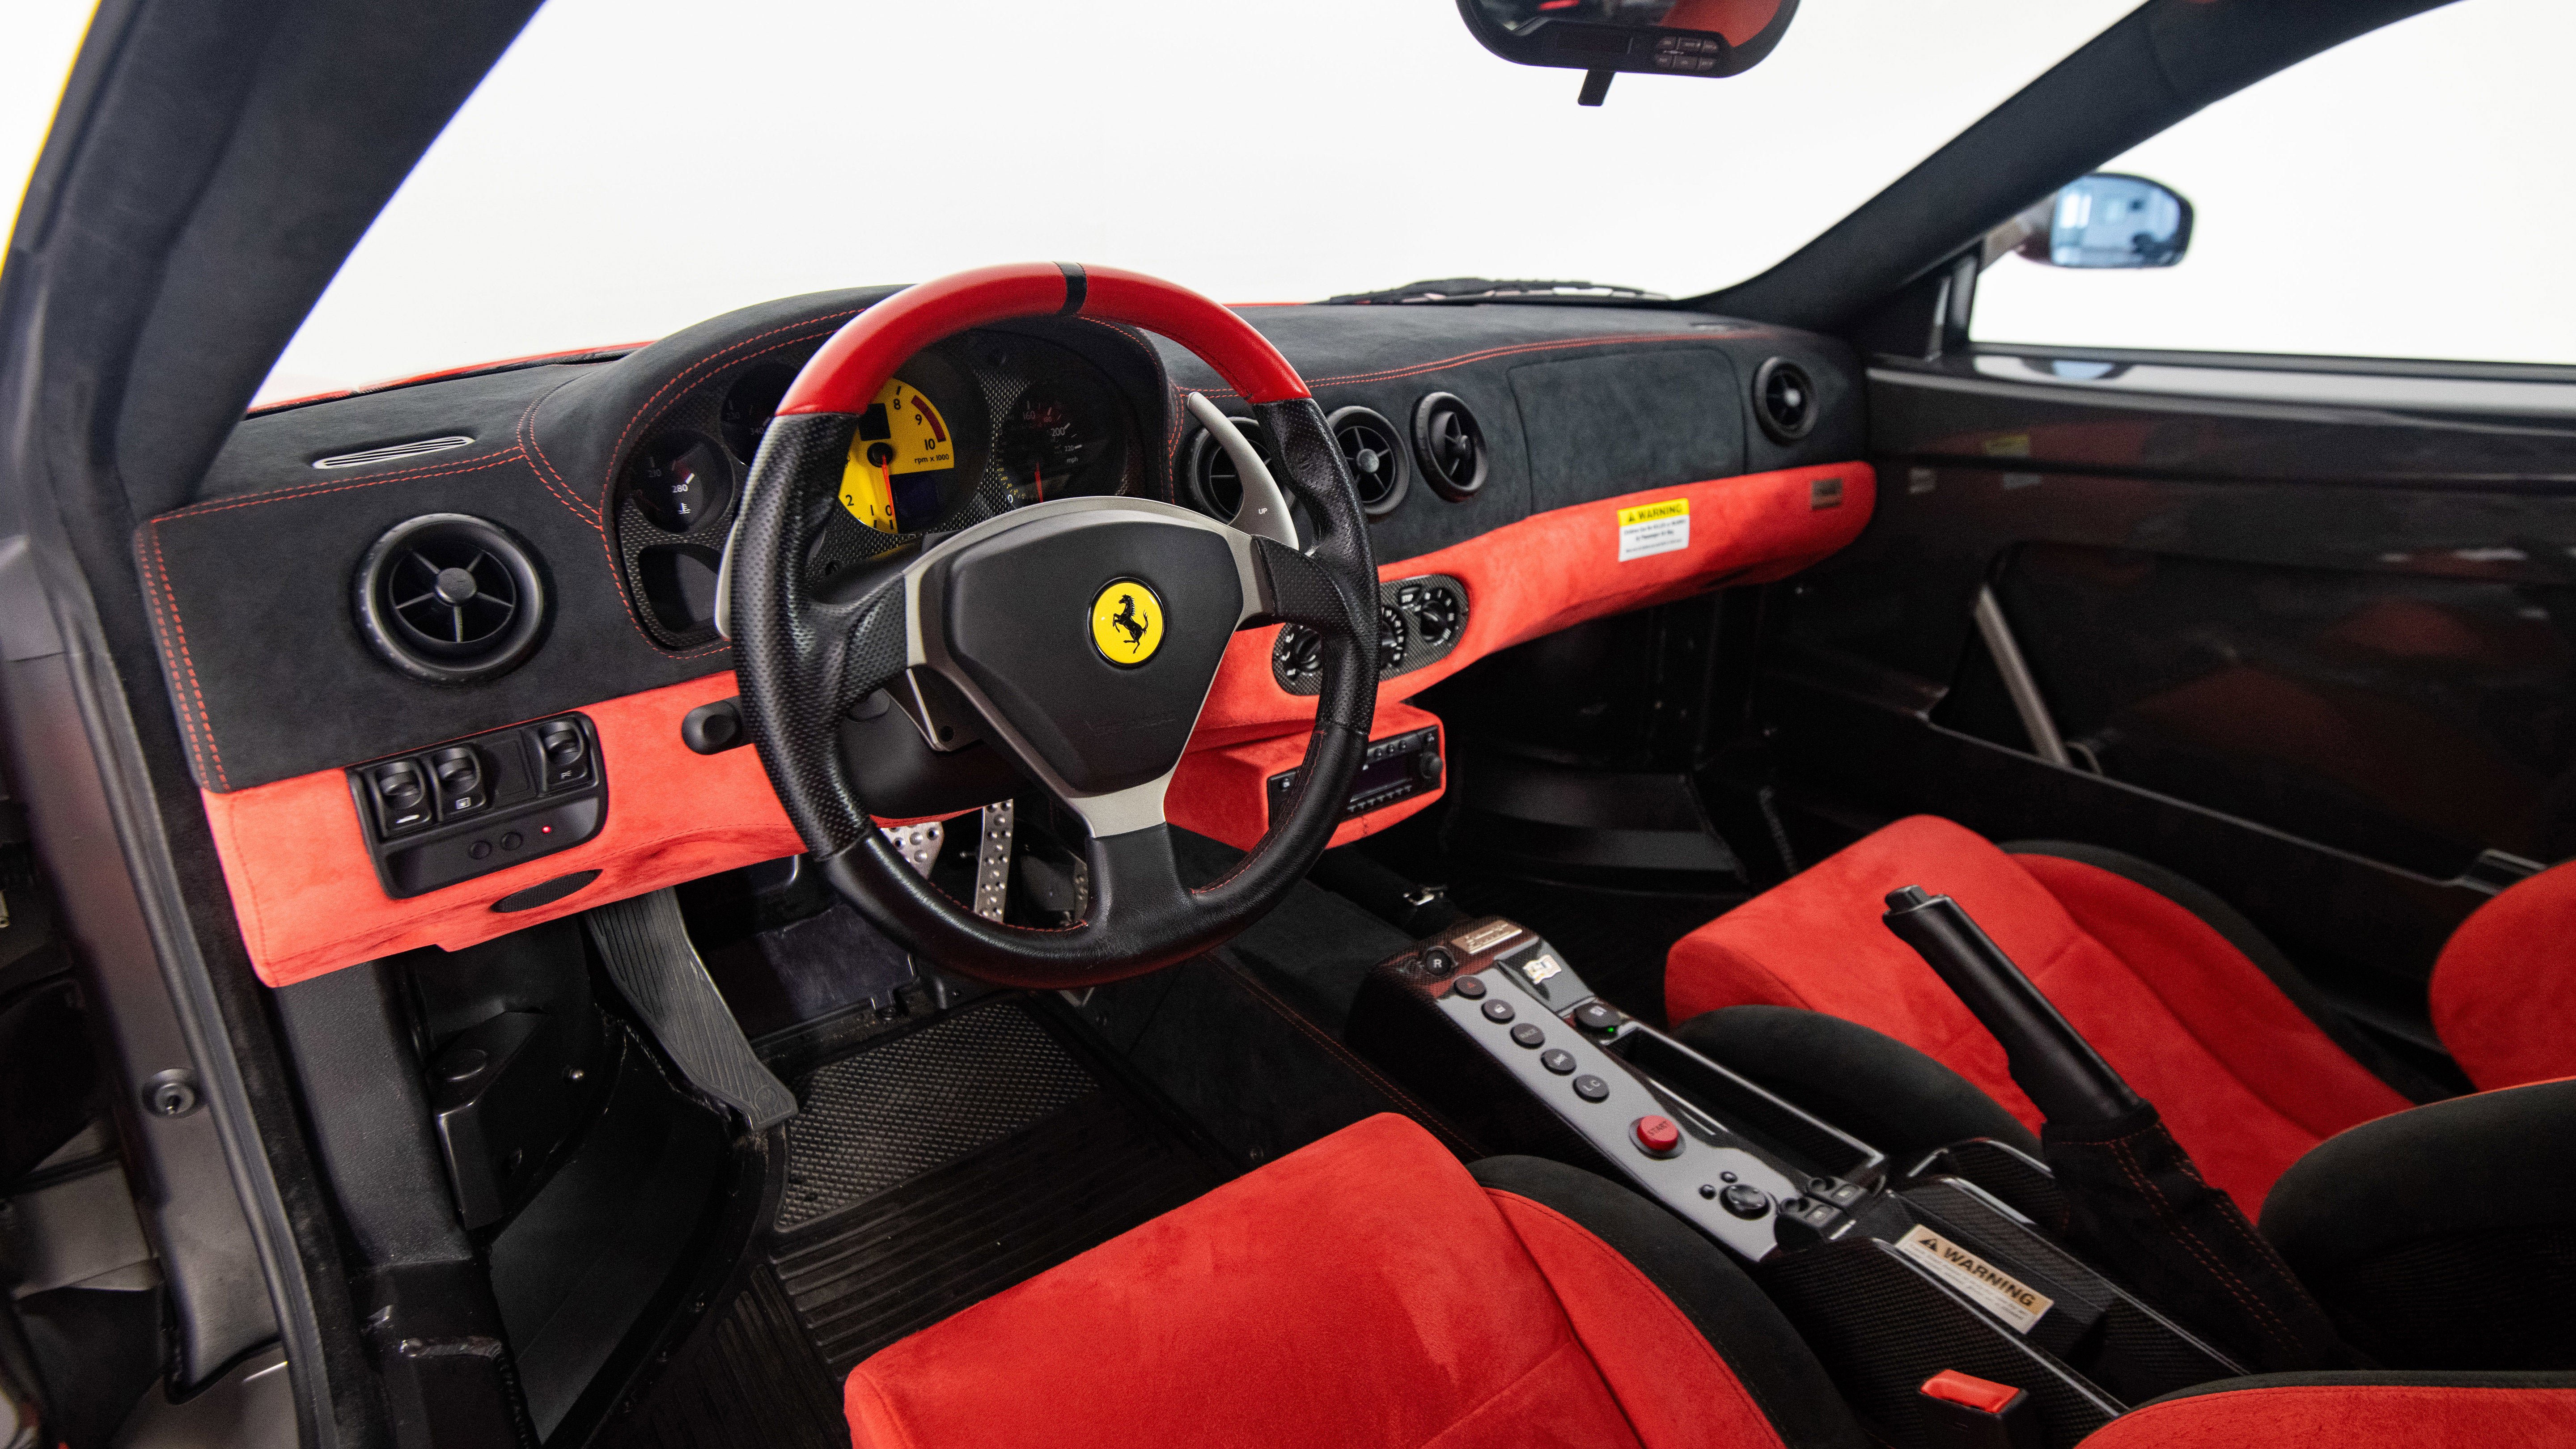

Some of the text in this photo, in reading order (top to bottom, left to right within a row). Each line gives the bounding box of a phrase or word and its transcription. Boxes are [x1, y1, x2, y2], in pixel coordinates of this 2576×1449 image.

[893, 398, 901, 410] 8
[915, 414, 922, 425] 9
[1022, 410, 1036, 420] 160
[1051, 427, 1065, 436] 200
[924, 438, 936, 450] 10
[671, 483, 689, 493] 280
[845, 494, 854, 506] 2
[870, 504, 874, 516] 1
[885, 504, 893, 517] 0
[1638, 504, 1682, 520] WARNING
[1433, 959, 1442, 968] R
[1647, 1120, 1669, 1136] START
[1943, 1247, 2037, 1307] WARNING
